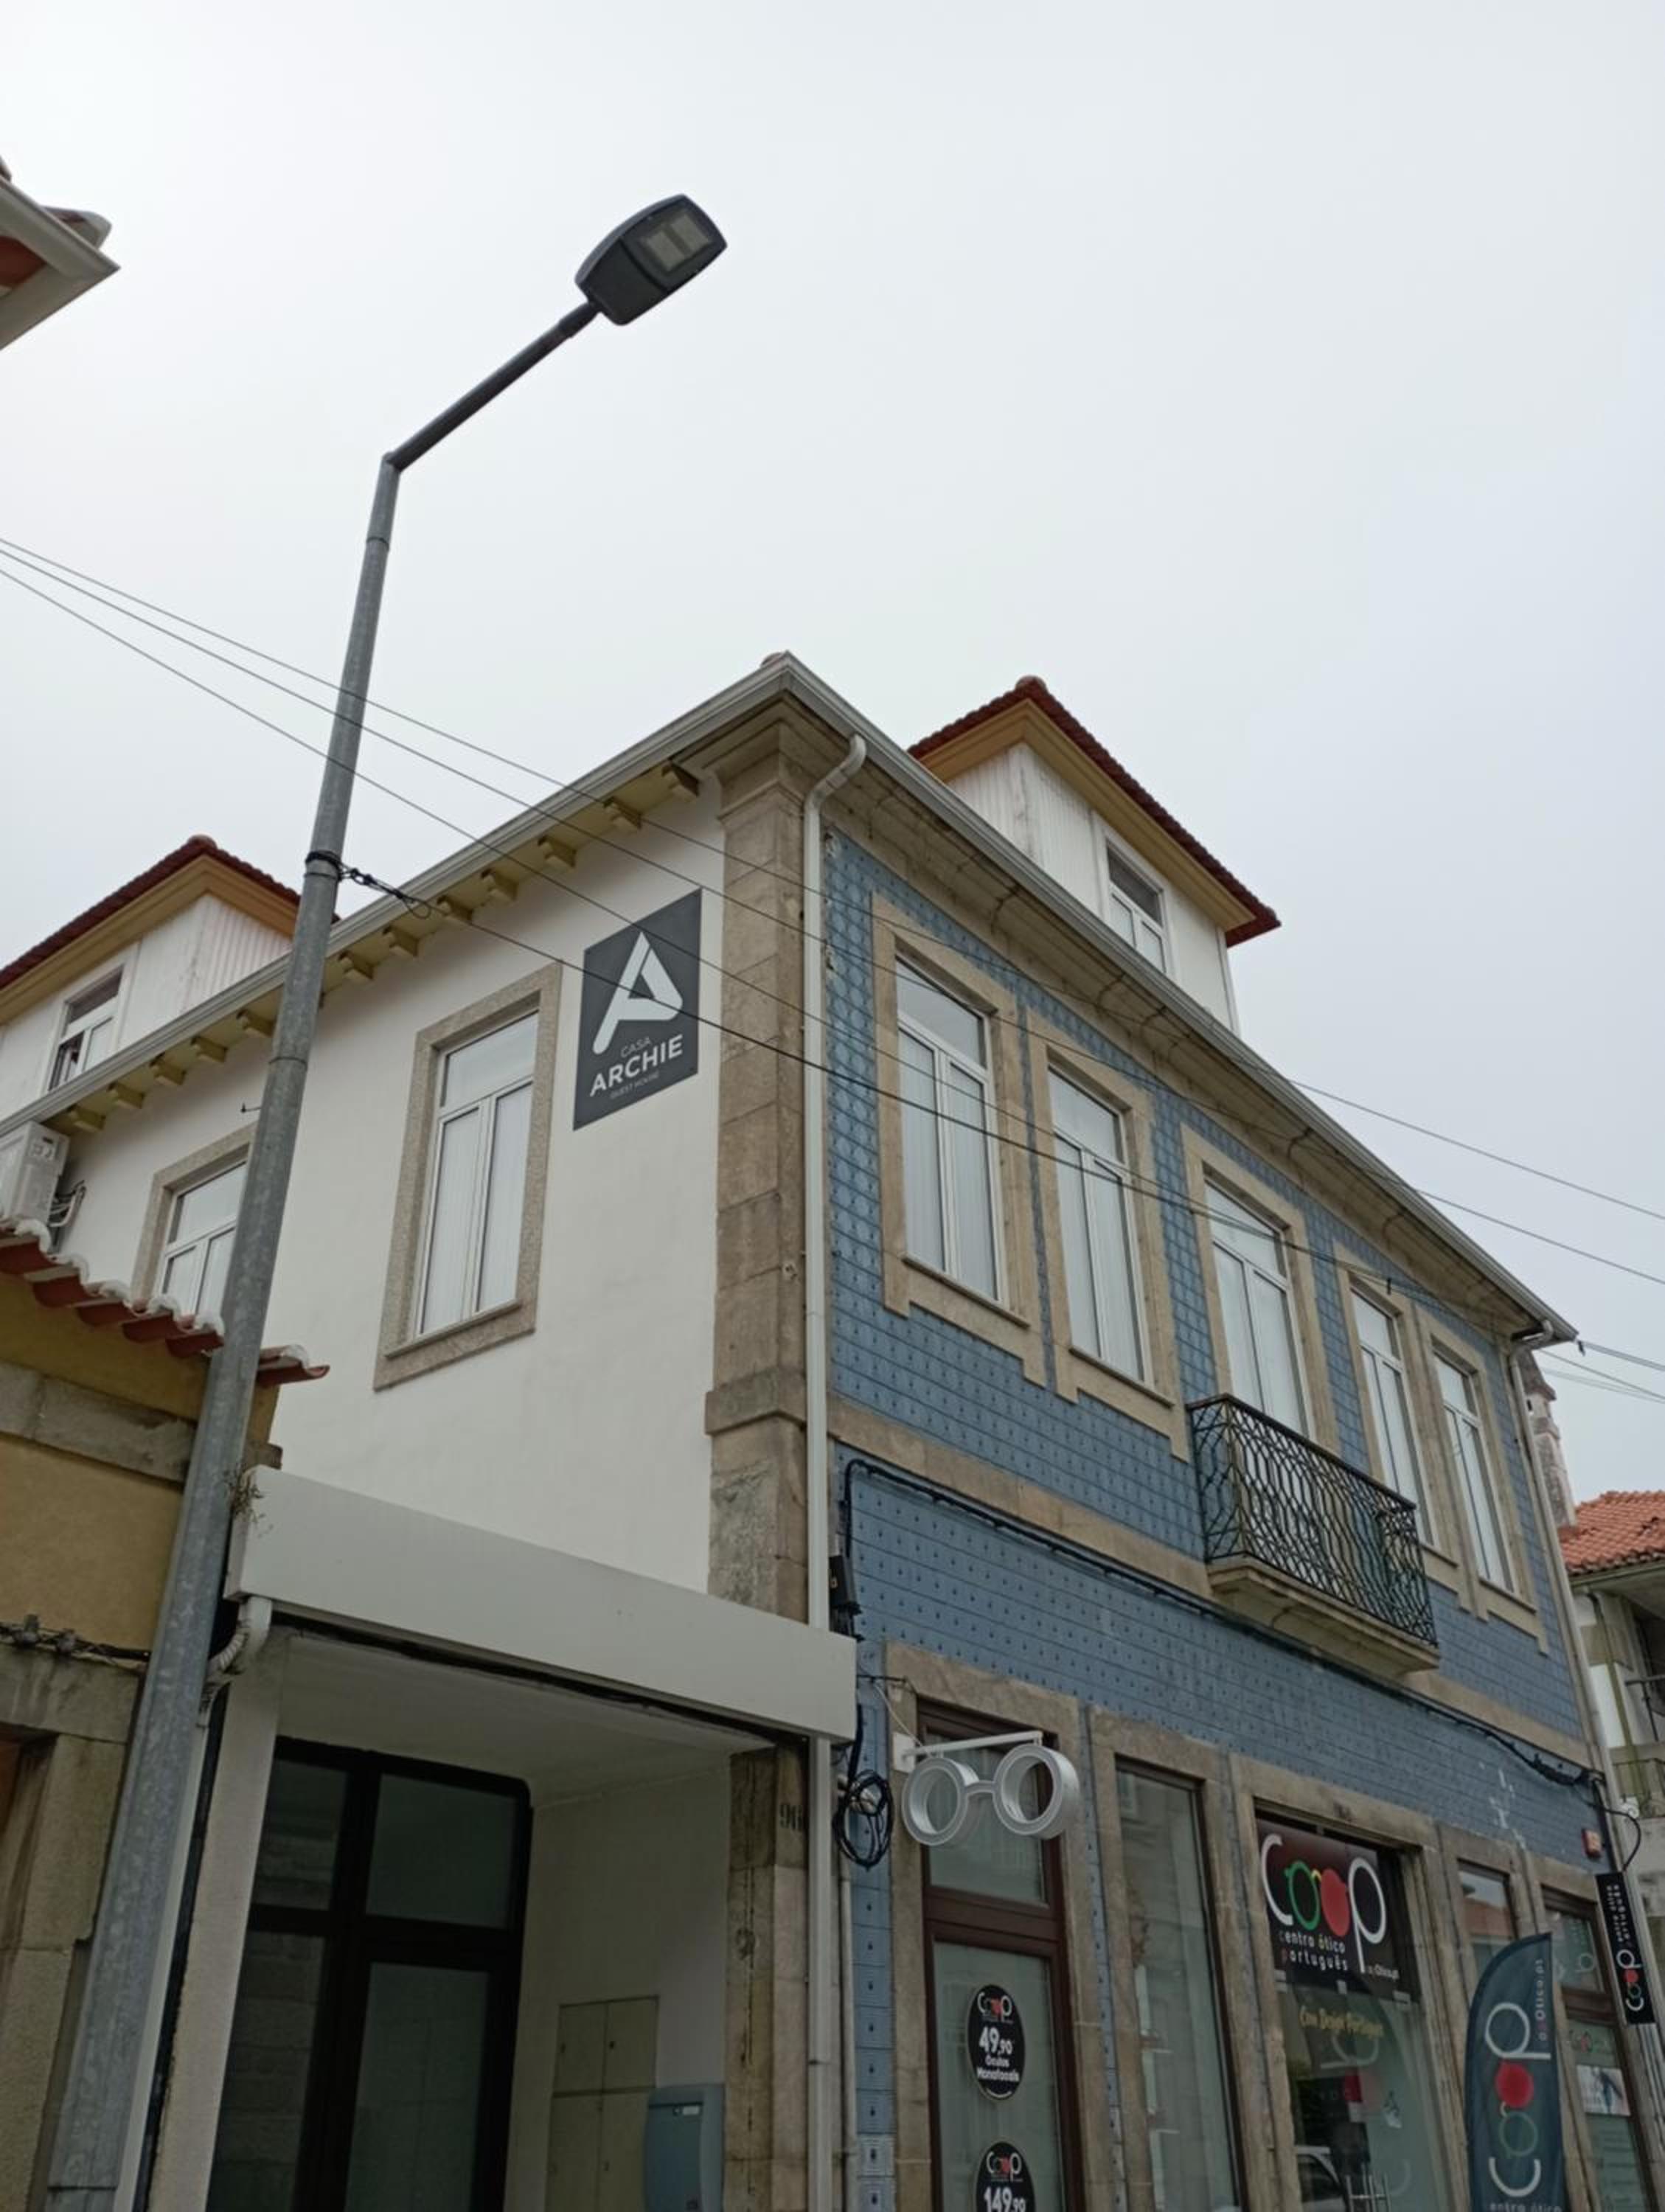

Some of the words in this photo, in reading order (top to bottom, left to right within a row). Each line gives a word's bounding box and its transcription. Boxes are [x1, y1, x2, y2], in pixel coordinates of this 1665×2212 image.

[593, 931, 684, 1054] A
[620, 1036, 653, 1058] CASA
[590, 1034, 684, 1097] ARCHIE
[1318, 1933, 1346, 1954] ótico
[1281, 1947, 1348, 1972] português
